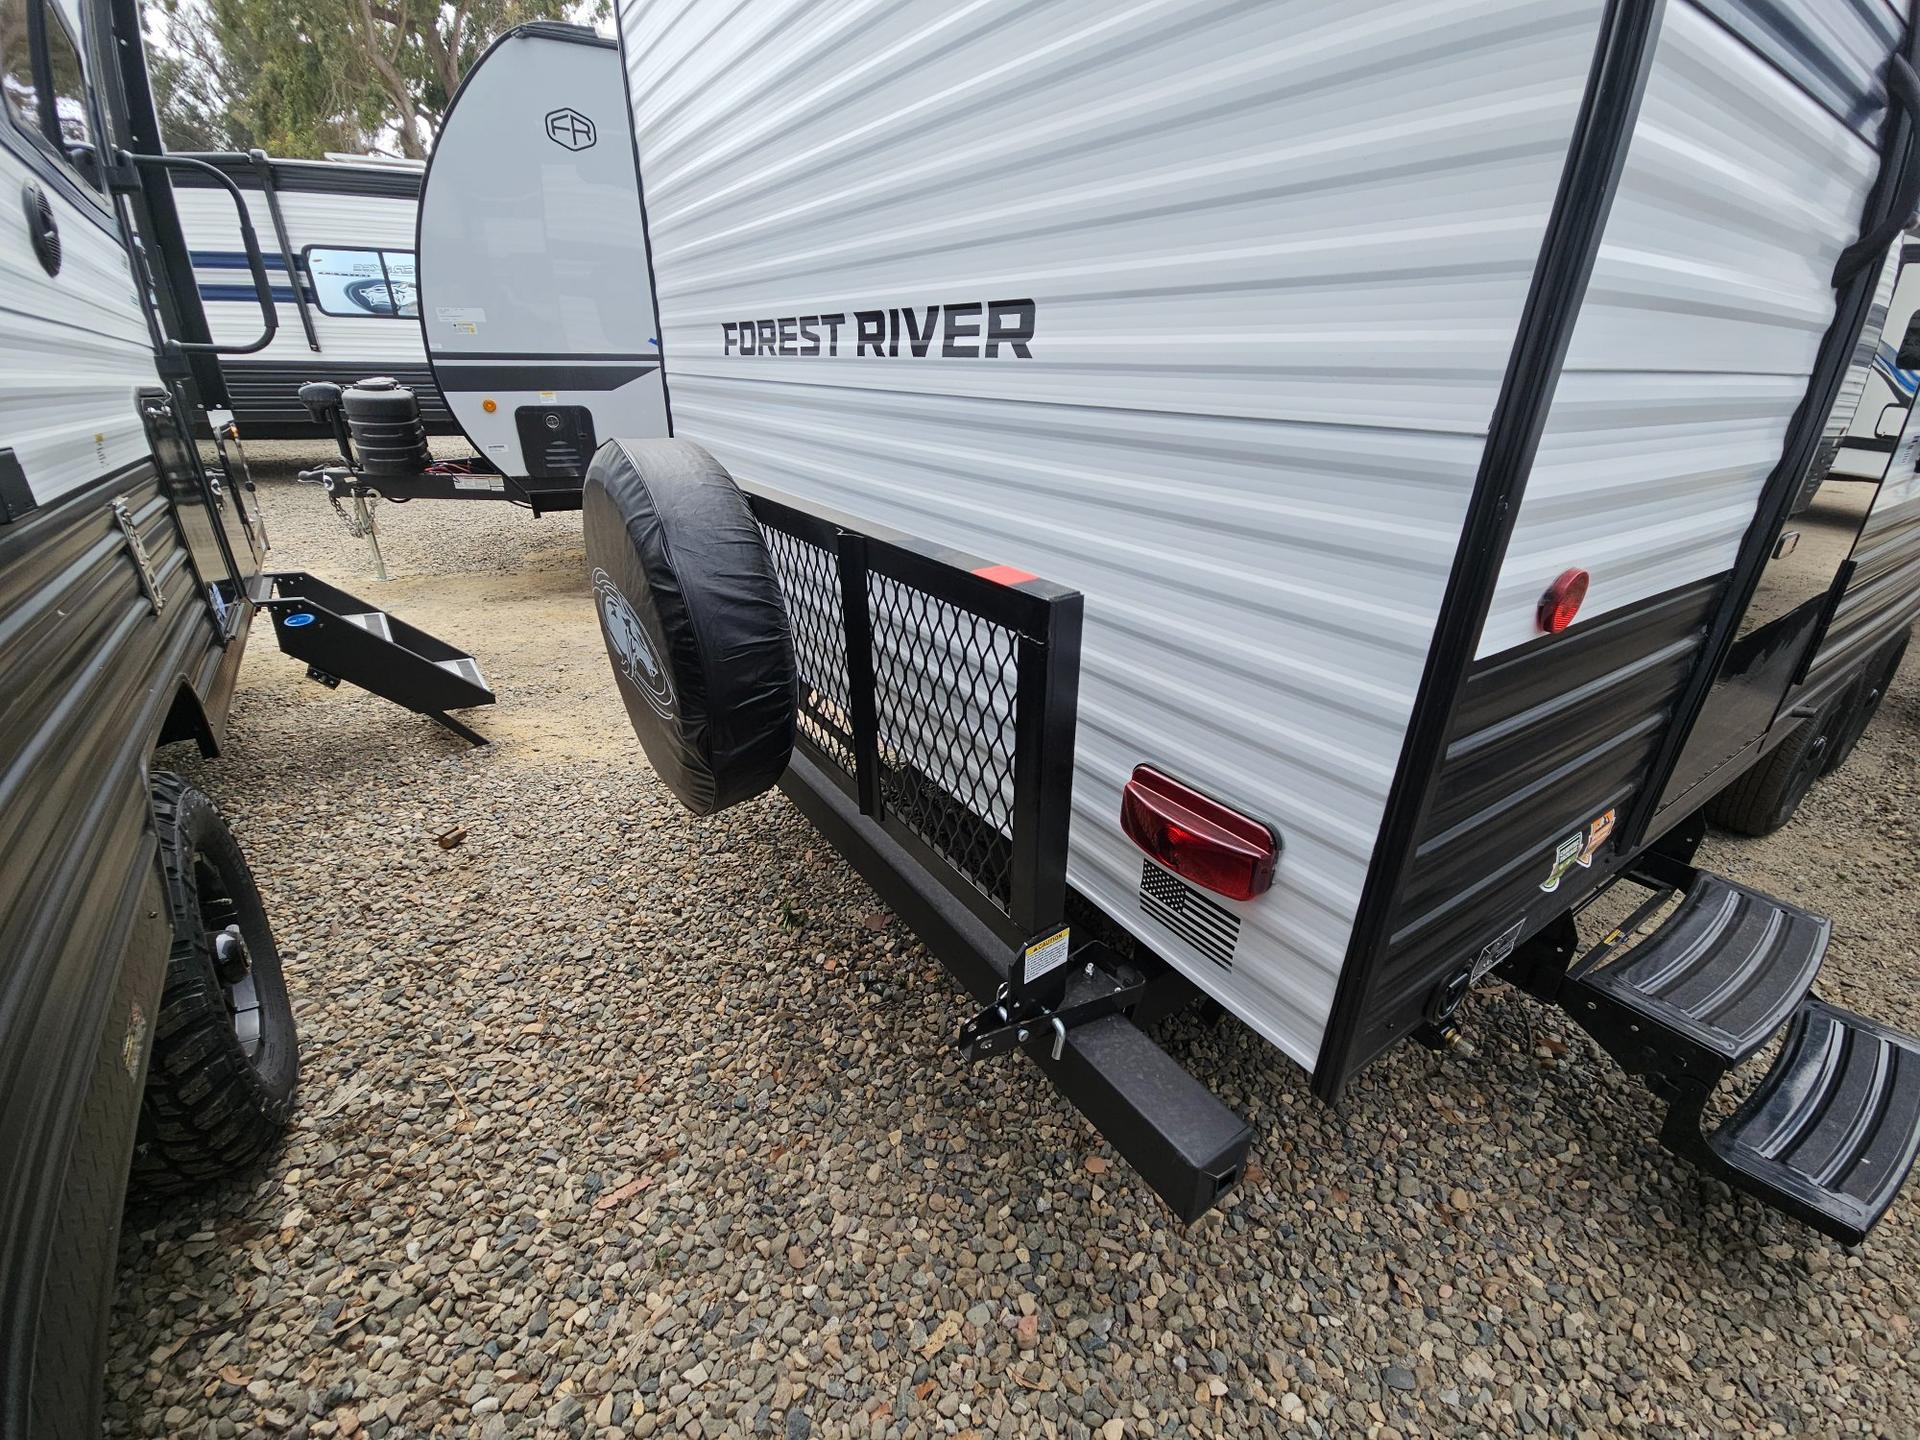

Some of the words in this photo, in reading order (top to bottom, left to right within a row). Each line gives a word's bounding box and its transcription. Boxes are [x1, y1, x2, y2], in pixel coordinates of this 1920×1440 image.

[721, 312, 846, 357] FOREST
[853, 298, 1036, 359] RIVER
[1039, 933, 1063, 949] CAUTION
